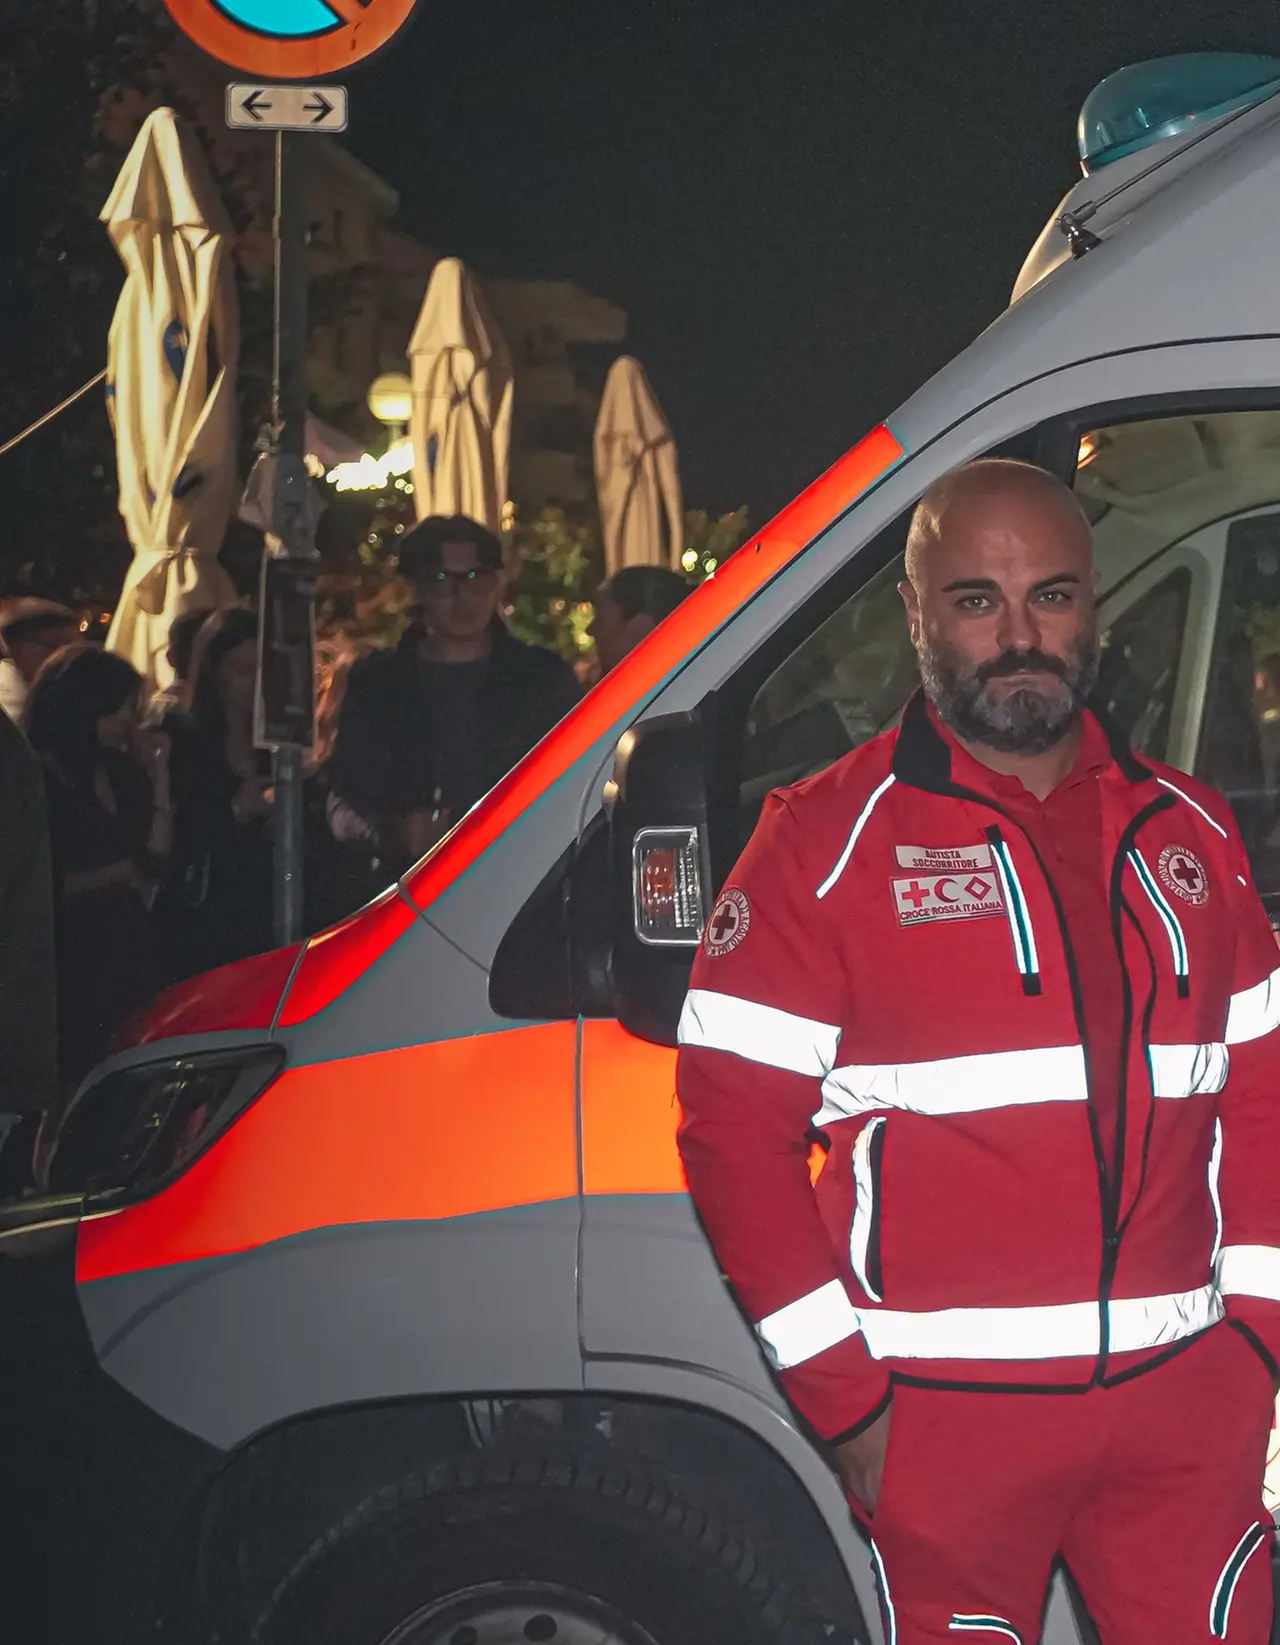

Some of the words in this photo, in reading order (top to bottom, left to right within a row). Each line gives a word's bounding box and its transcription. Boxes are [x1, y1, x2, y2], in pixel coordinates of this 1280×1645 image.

[925, 850, 961, 859] AUTISTA
[912, 858, 979, 868] SOCCORRITORE
[900, 909, 930, 920] CROCE
[932, 905, 962, 916] ROSSA
[963, 901, 1002, 912] ITALIANA
